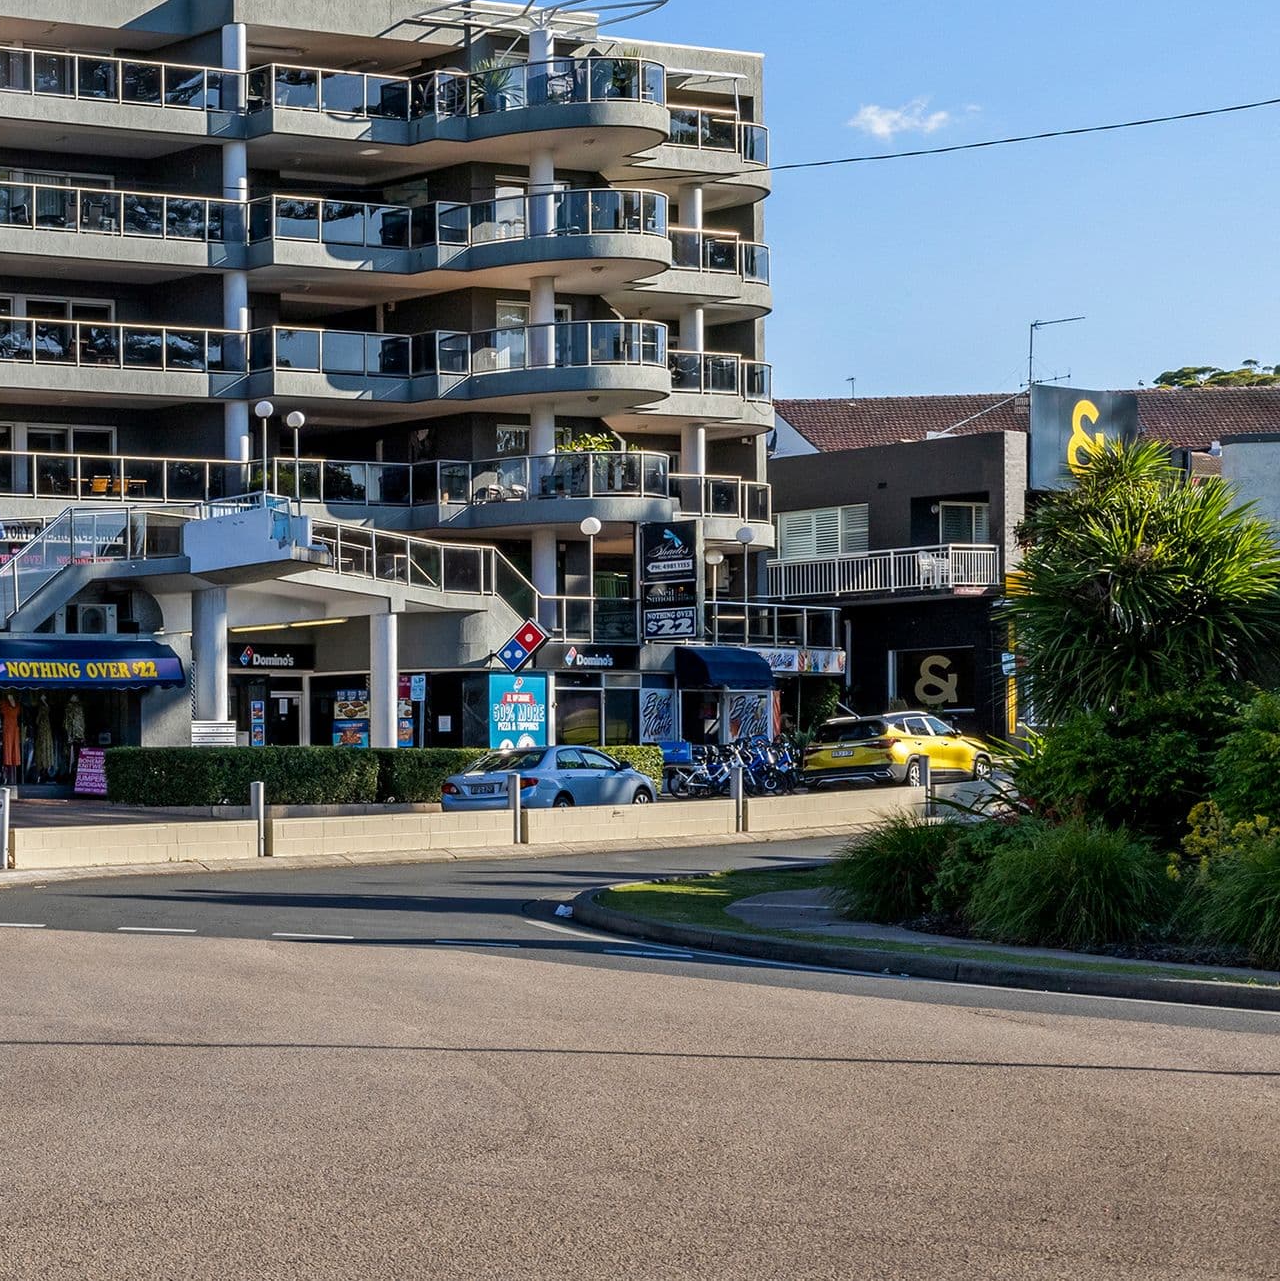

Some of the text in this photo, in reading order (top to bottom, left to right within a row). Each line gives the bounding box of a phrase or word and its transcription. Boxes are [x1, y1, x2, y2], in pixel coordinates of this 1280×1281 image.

[3, 525, 30, 540] TORY
[647, 609, 694, 620] NOTHING OVER
[647, 618, 693, 634] $22
[253, 653, 294, 667] Domino's
[576, 654, 614, 667] Domino's
[5, 660, 81, 679] NOTHING
[87, 661, 131, 679] OVER
[132, 661, 157, 678] $22
[914, 655, 958, 705] &
[493, 703, 545, 722] 50% MORE
